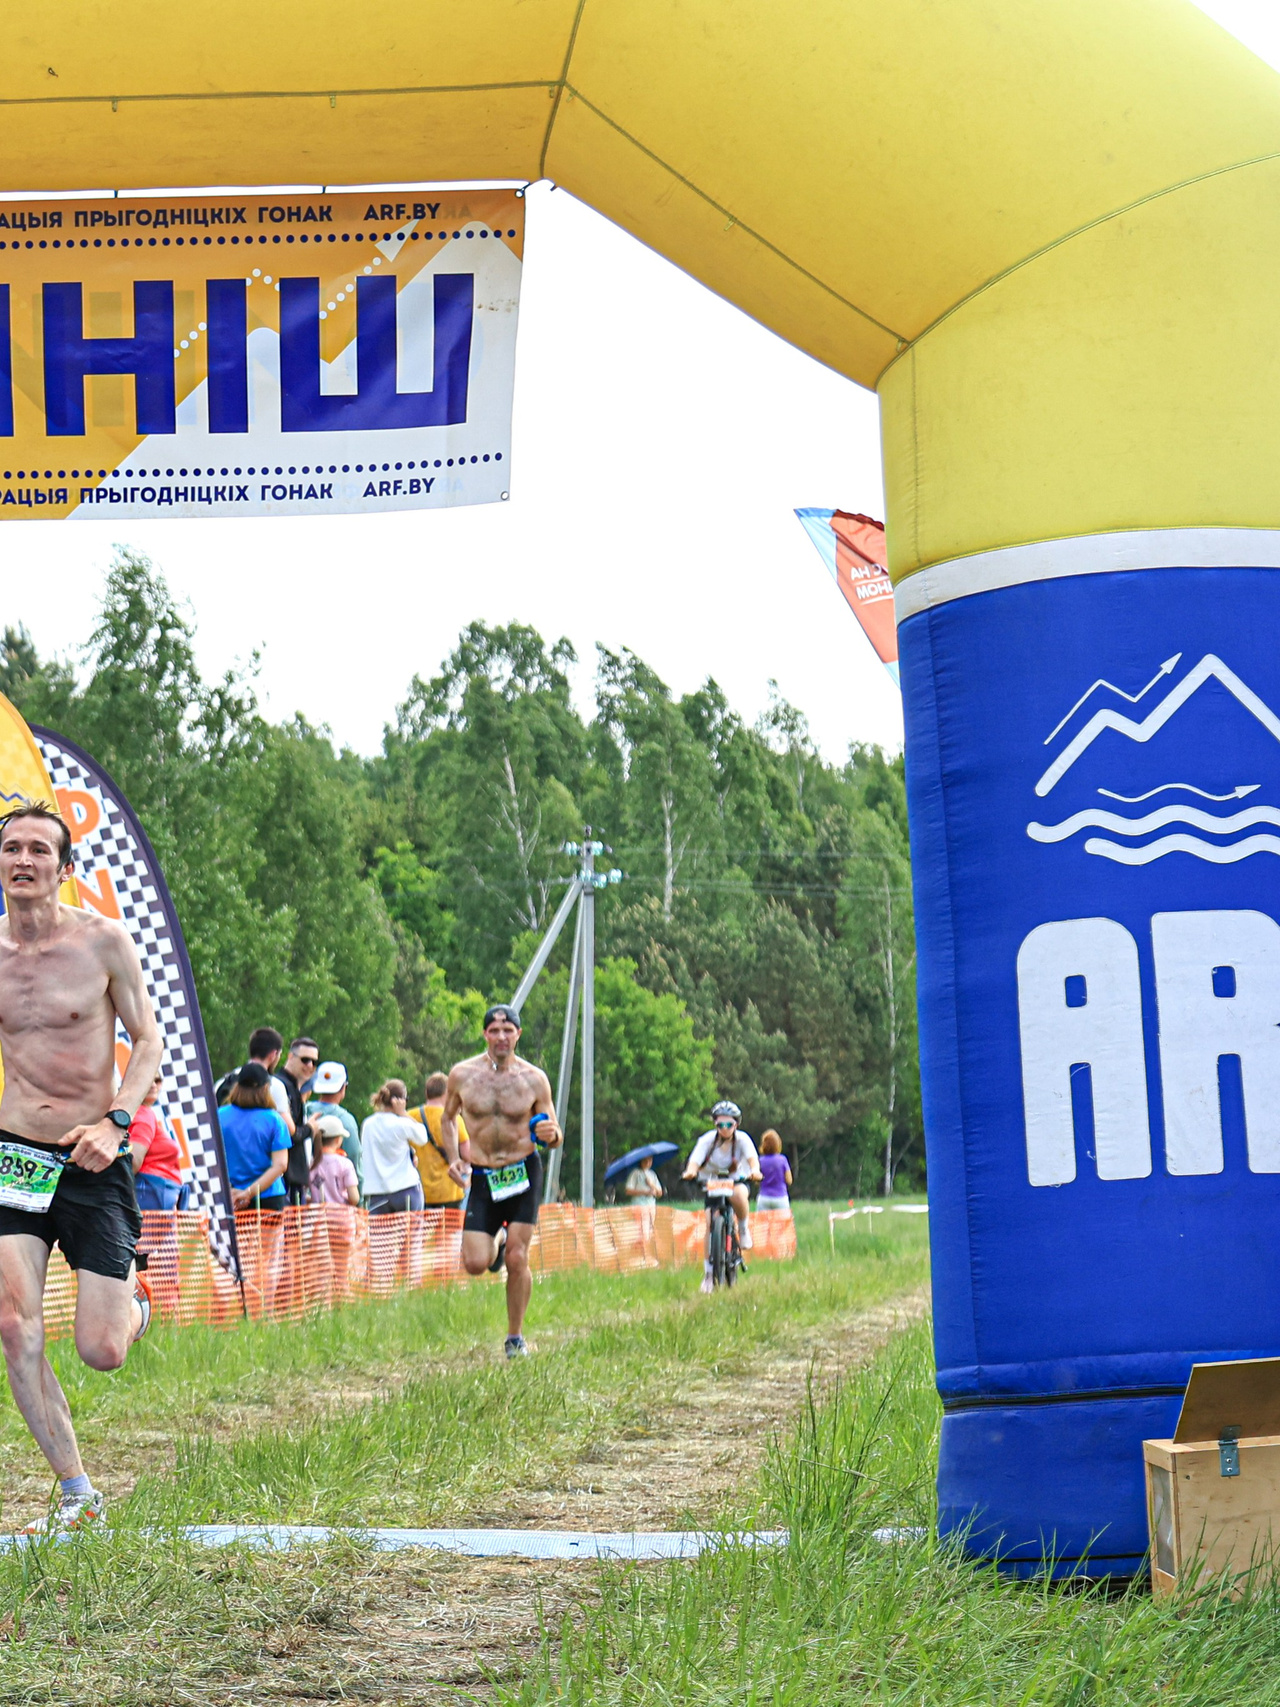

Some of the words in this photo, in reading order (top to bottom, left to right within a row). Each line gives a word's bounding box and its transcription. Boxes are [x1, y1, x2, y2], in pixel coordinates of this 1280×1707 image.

[74, 206, 247, 229] ПРЫГОДНІЦКІХ
[258, 205, 333, 224] ГОНАК
[363, 202, 441, 221] ARF.BY
[80, 484, 250, 506] ПРЫГОДНІЦКІХ
[260, 483, 334, 501] ГОНАК
[362, 477, 437, 498] ARF.BY
[1016, 909, 1280, 1187] AR
